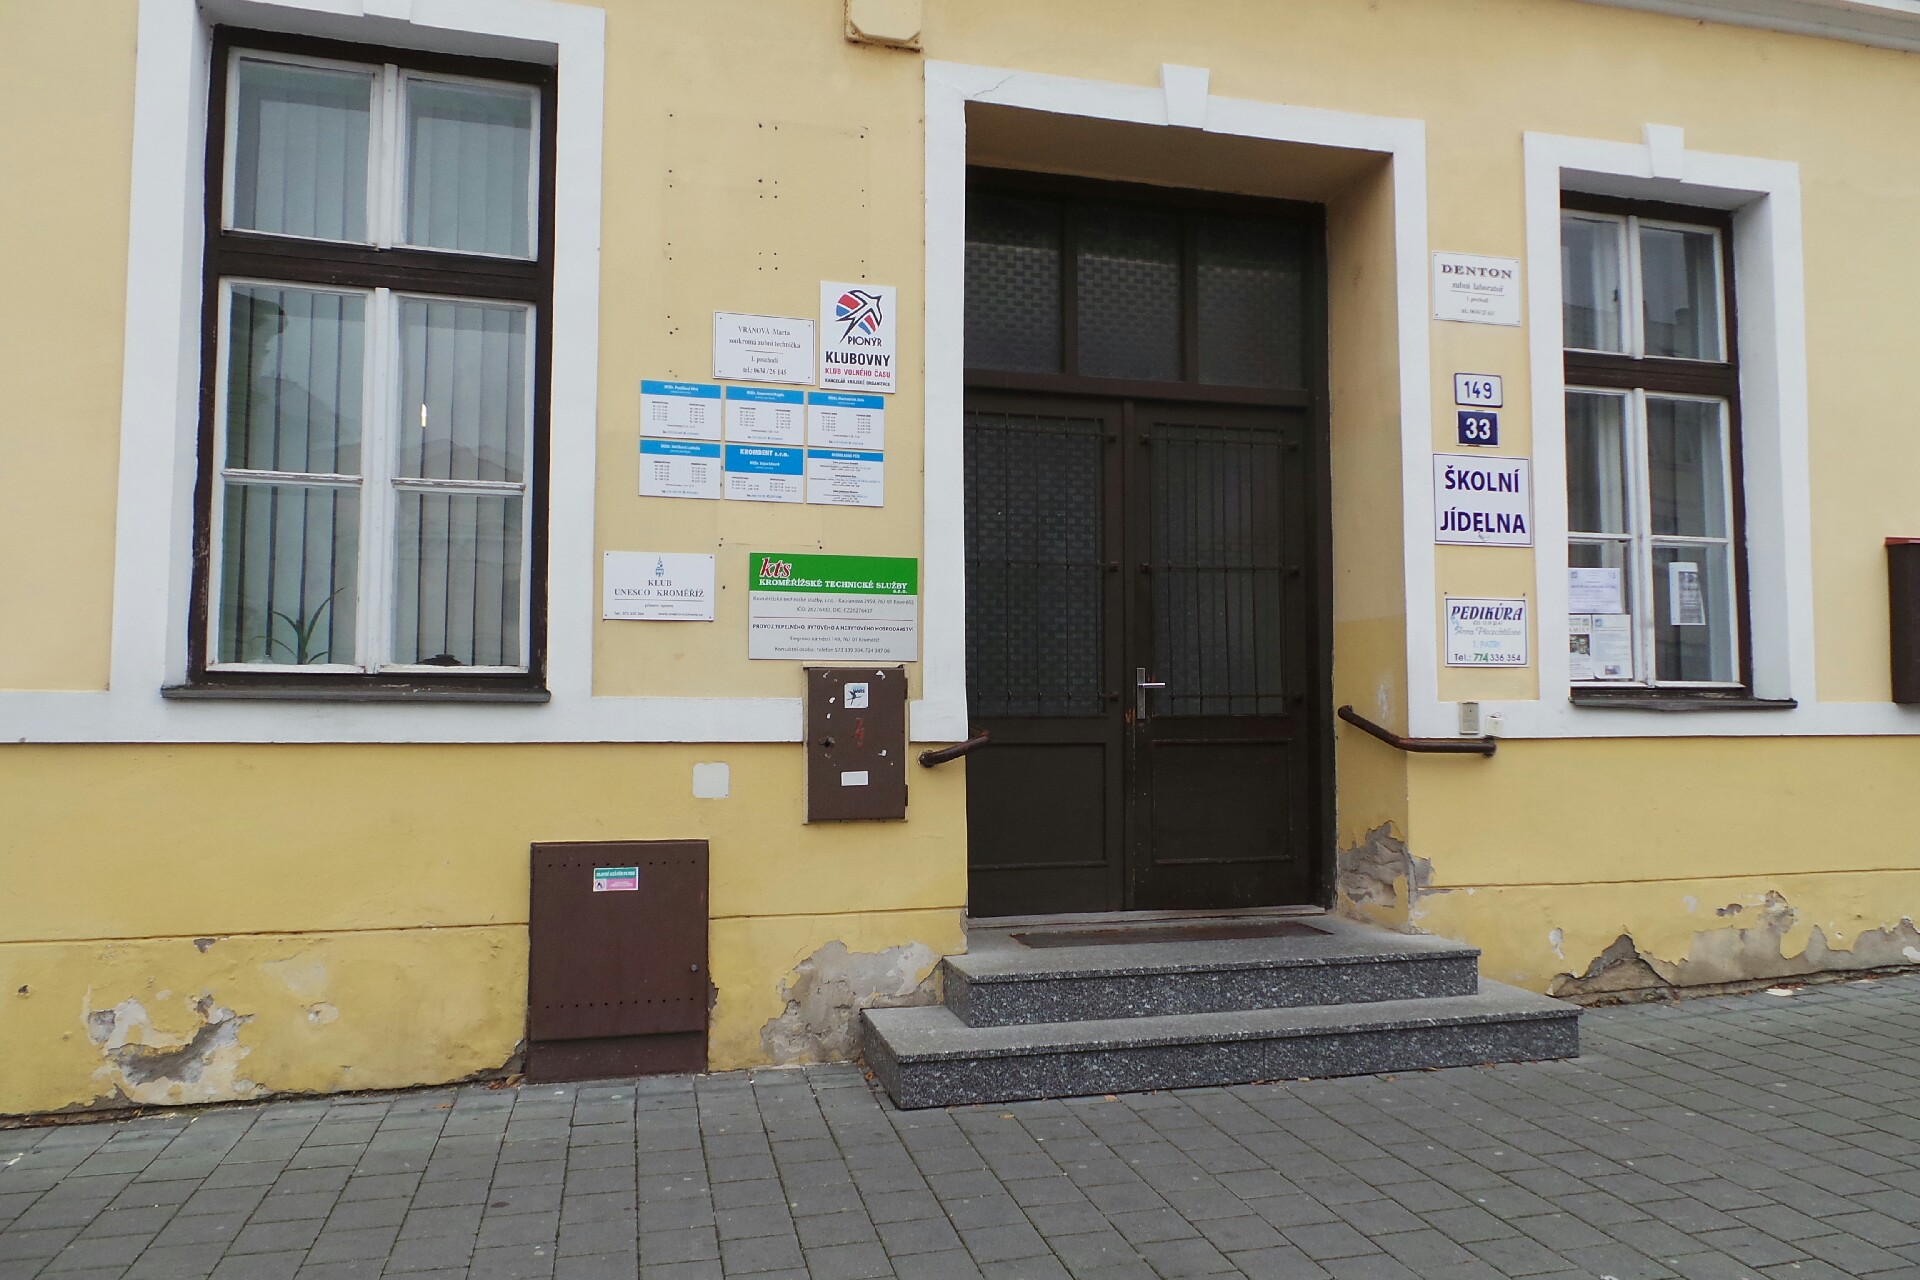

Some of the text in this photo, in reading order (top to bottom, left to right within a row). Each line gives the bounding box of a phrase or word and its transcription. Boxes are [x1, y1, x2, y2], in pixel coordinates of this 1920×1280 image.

[1441, 263, 1512, 279] DENTON
[773, 328, 790, 336] Marta
[847, 335, 883, 347] PIONÝR
[825, 350, 891, 367] KLUBOVNY
[825, 367, 891, 378] KLUB VOLNÉHO ČASU
[1463, 380, 1493, 400] 149
[1465, 417, 1491, 440] 33
[1444, 464, 1520, 493] ŠKOLNÍ
[1440, 506, 1526, 534] JÍDELNA
[759, 556, 792, 579] kts
[648, 579, 672, 587] KLUB
[759, 577, 908, 590] KROMĚŘÍŽSKÉ TECHNICKÉ SLUŽBY
[614, 588, 705, 598] UNESCO KROMĚŘÍŽ
[1450, 602, 1523, 621] PEDIKÚRA
[1454, 652, 1521, 663] Tel.: 774 336 354
